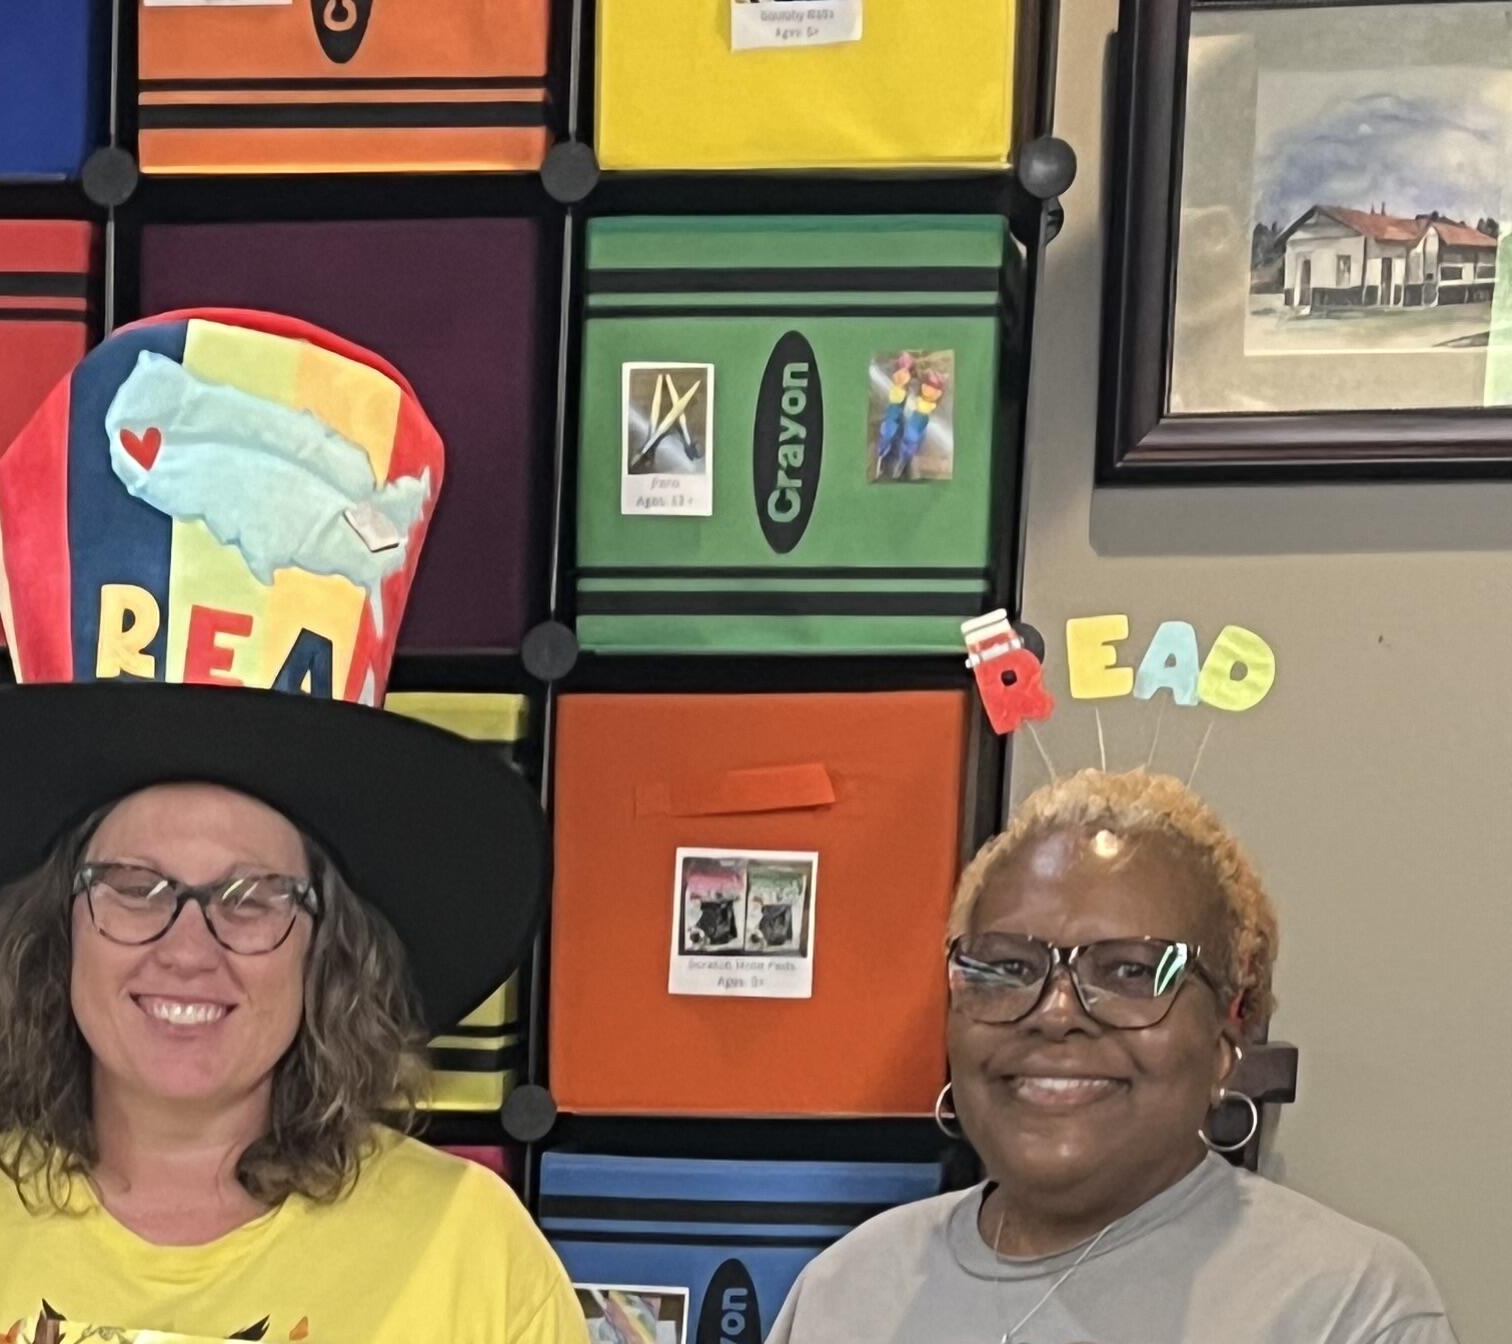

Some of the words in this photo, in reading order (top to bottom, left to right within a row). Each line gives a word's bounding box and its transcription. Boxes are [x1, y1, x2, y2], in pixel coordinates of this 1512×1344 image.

[767, 362, 810, 523] Crayon
[95, 584, 378, 705] REA
[972, 614, 1276, 736] READ
